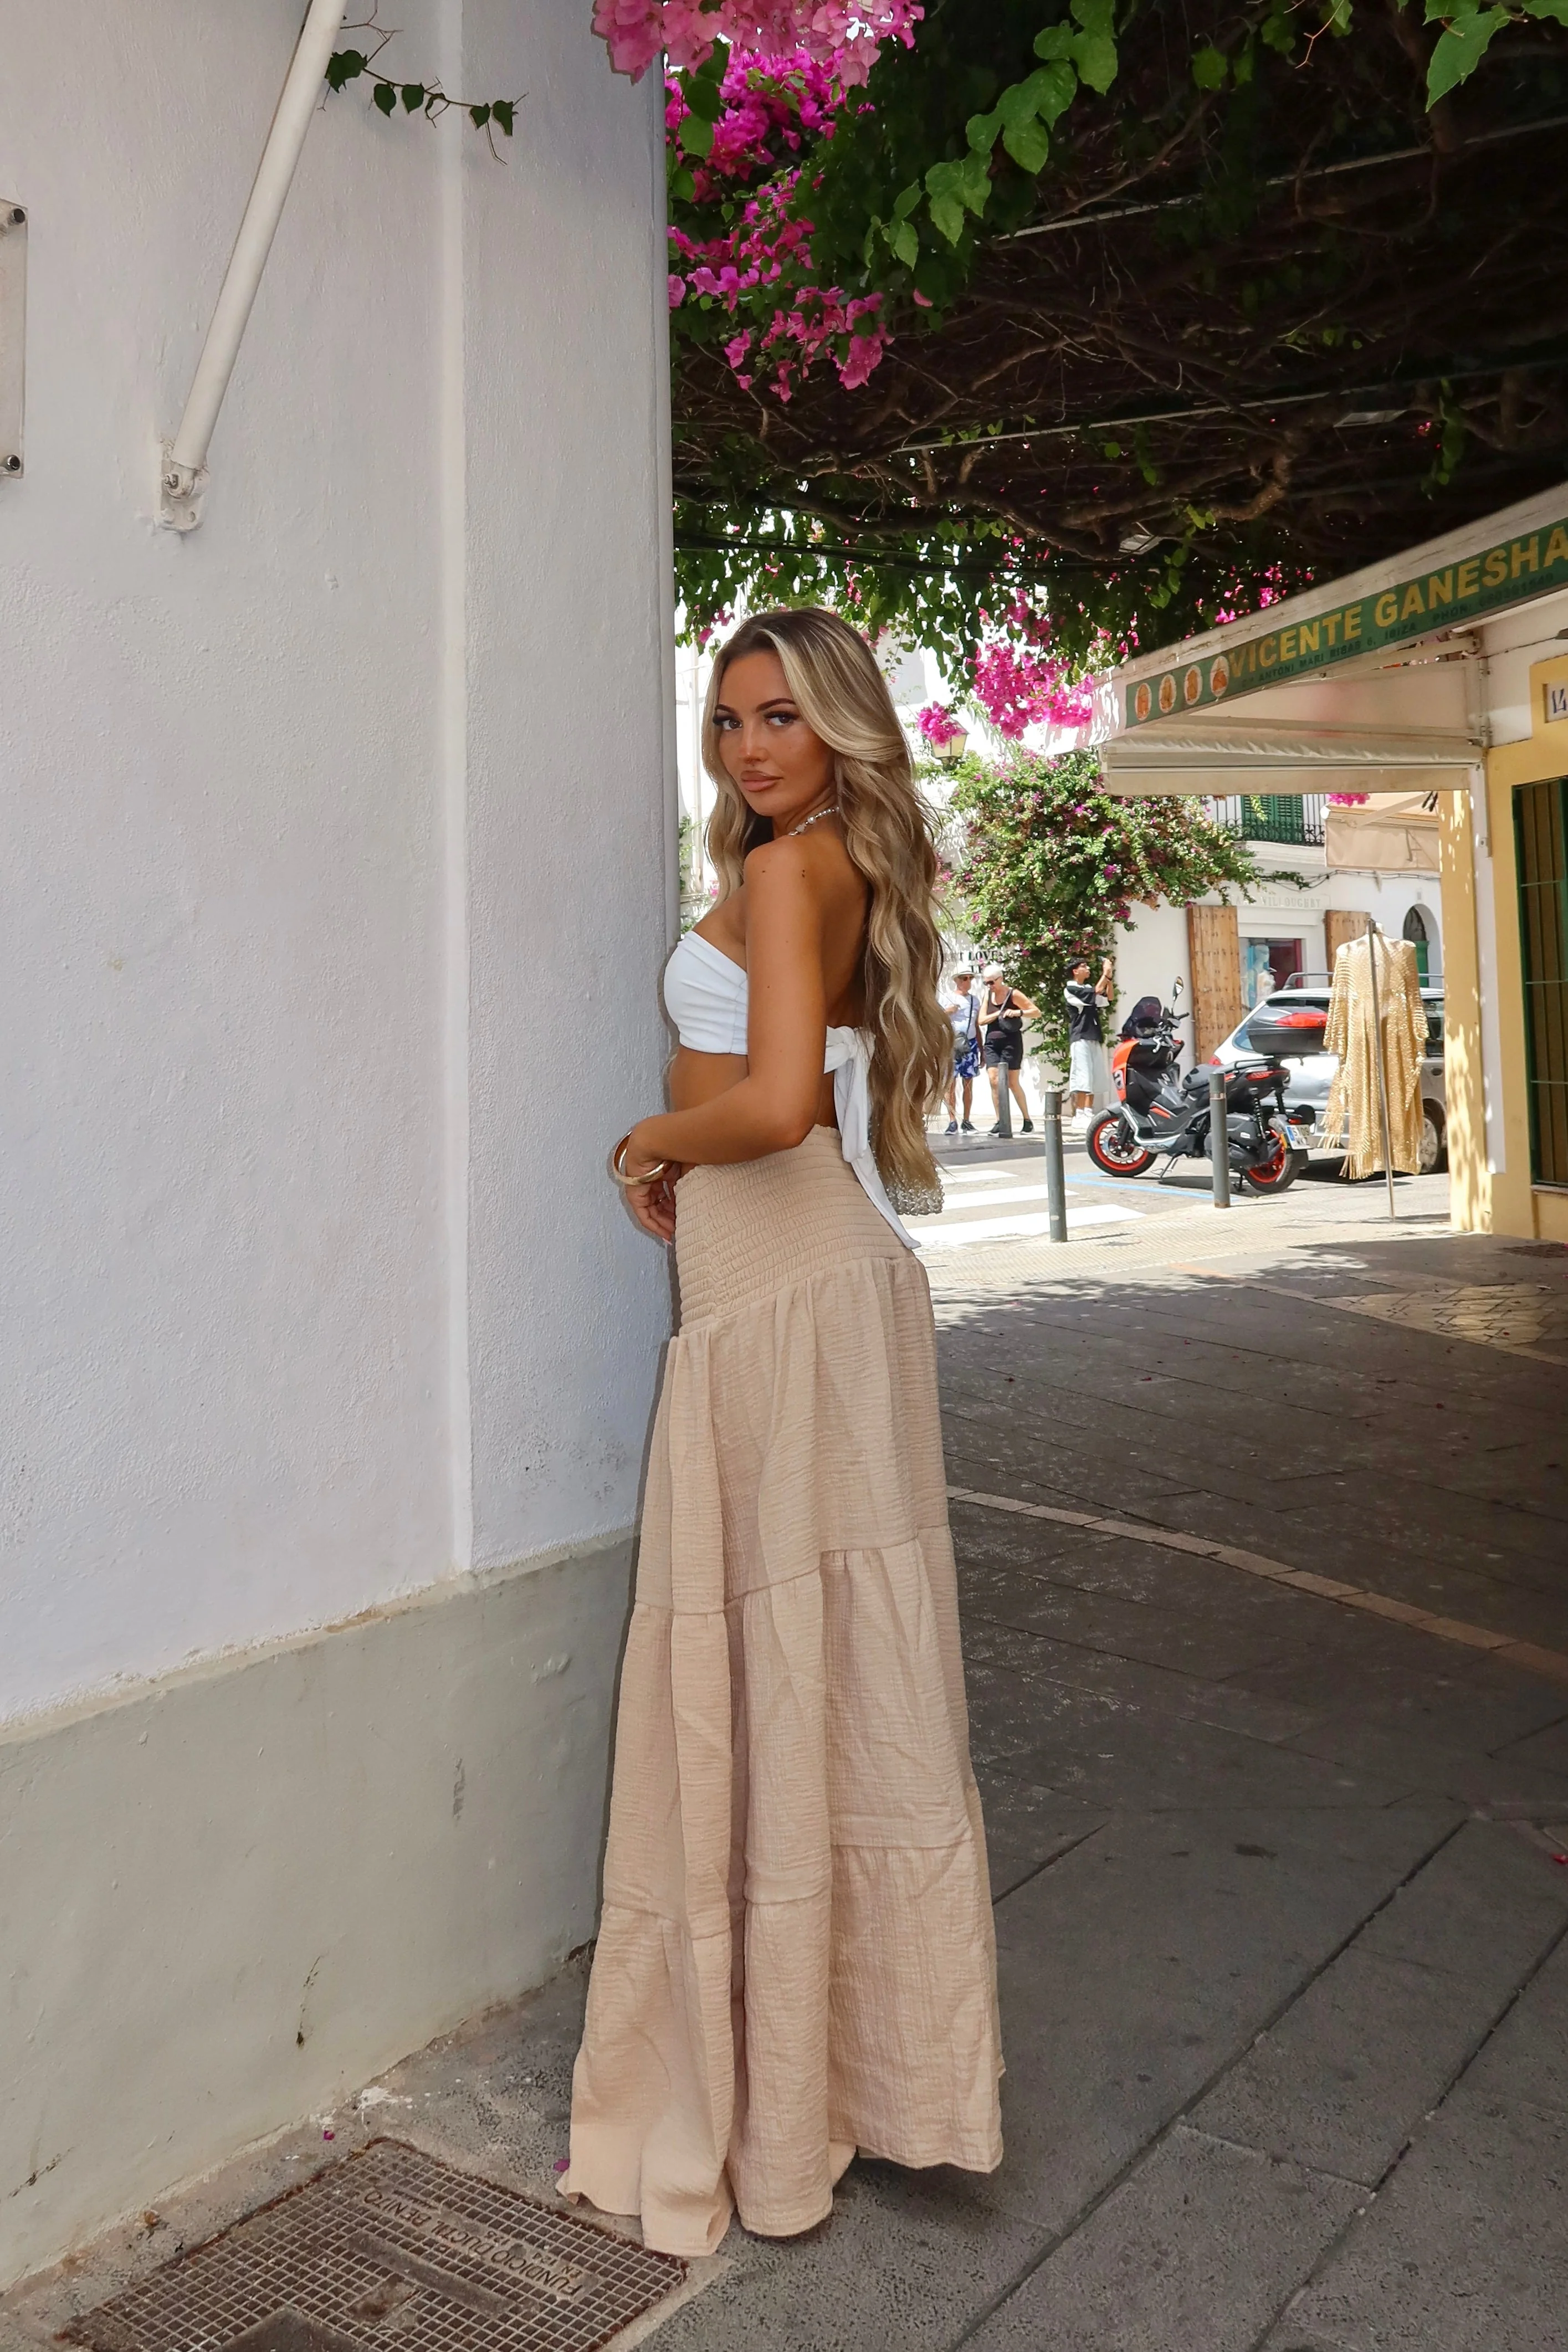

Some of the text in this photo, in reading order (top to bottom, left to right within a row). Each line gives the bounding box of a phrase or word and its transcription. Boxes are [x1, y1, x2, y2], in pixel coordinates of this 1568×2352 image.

[1228, 526, 1568, 678] VICENTE GANESHA
[1259, 664, 1294, 681] ANTONI
[1385, 622, 1416, 639] IBIZA
[364, 2190, 432, 2227] BENITO
[431, 2220, 494, 2255] DUCTIL
[561, 2266, 582, 2278] EN
